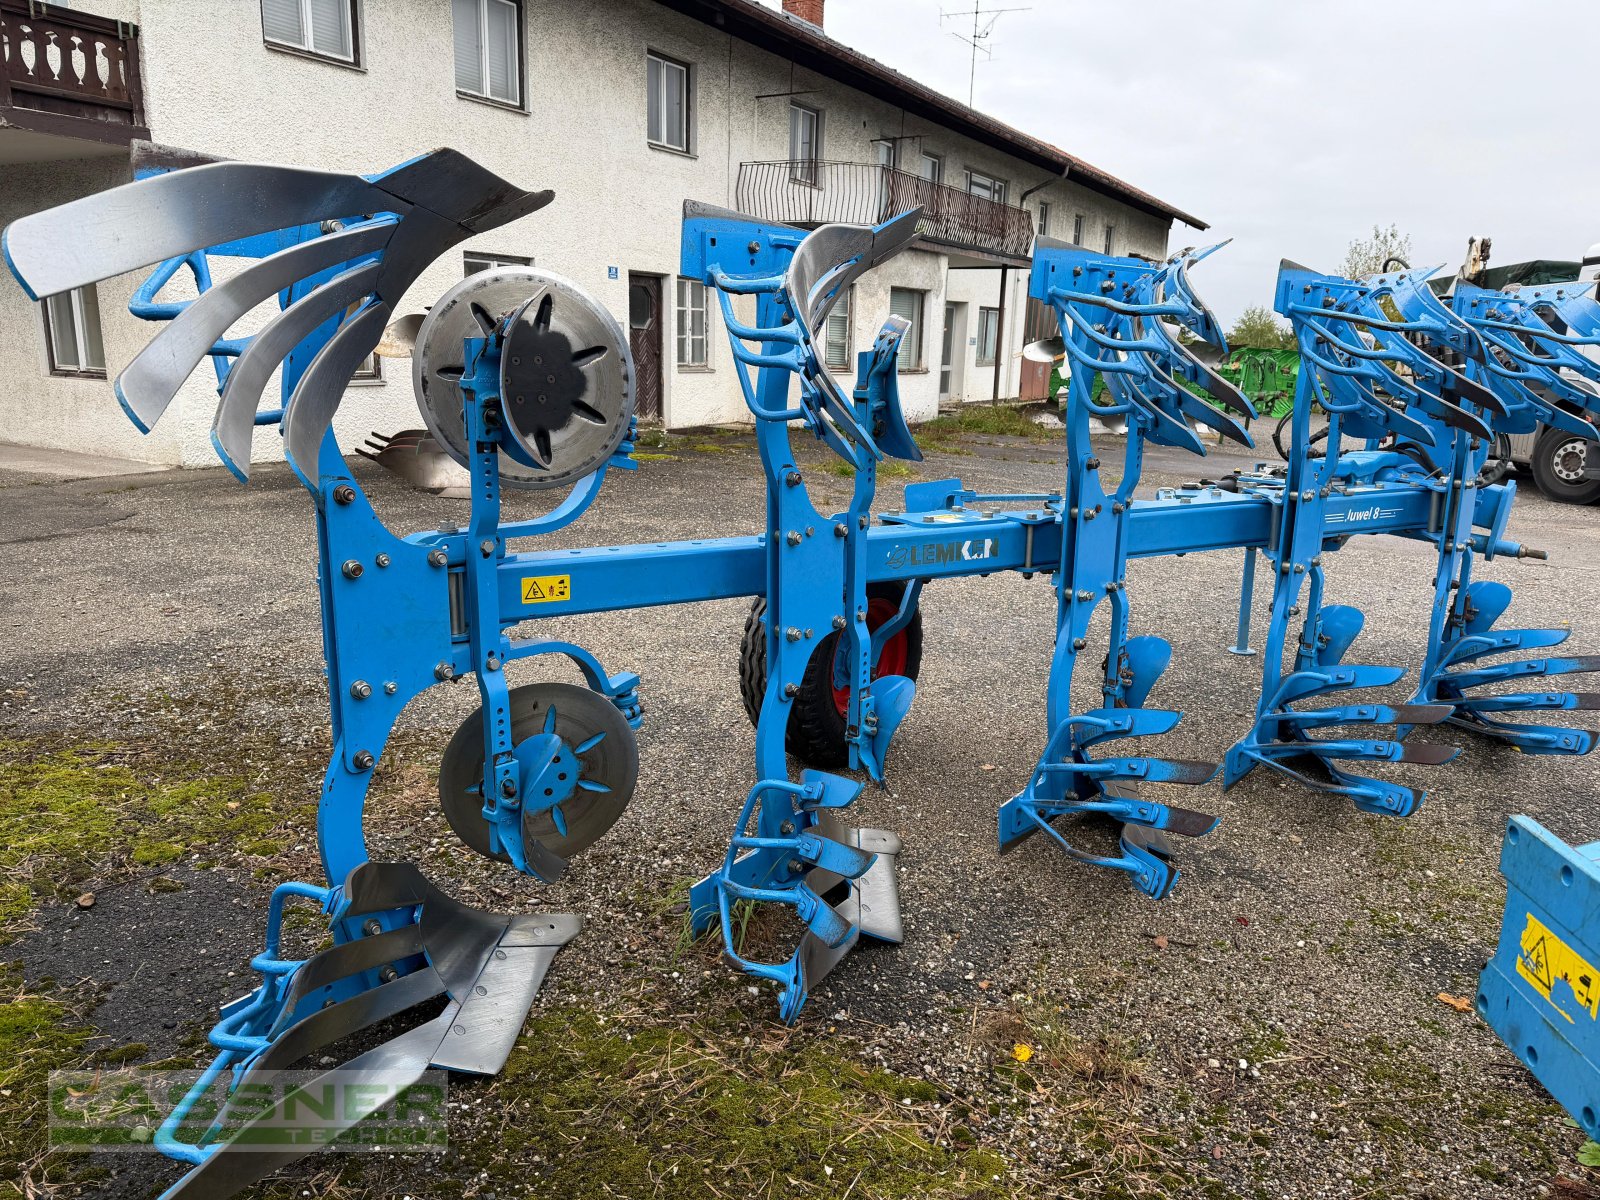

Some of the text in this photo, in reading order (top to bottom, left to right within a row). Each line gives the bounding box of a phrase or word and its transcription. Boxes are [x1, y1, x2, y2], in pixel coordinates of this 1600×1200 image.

[1344, 507, 1380, 522] Juwel 8
[910, 538, 999, 567] LEMKEN
